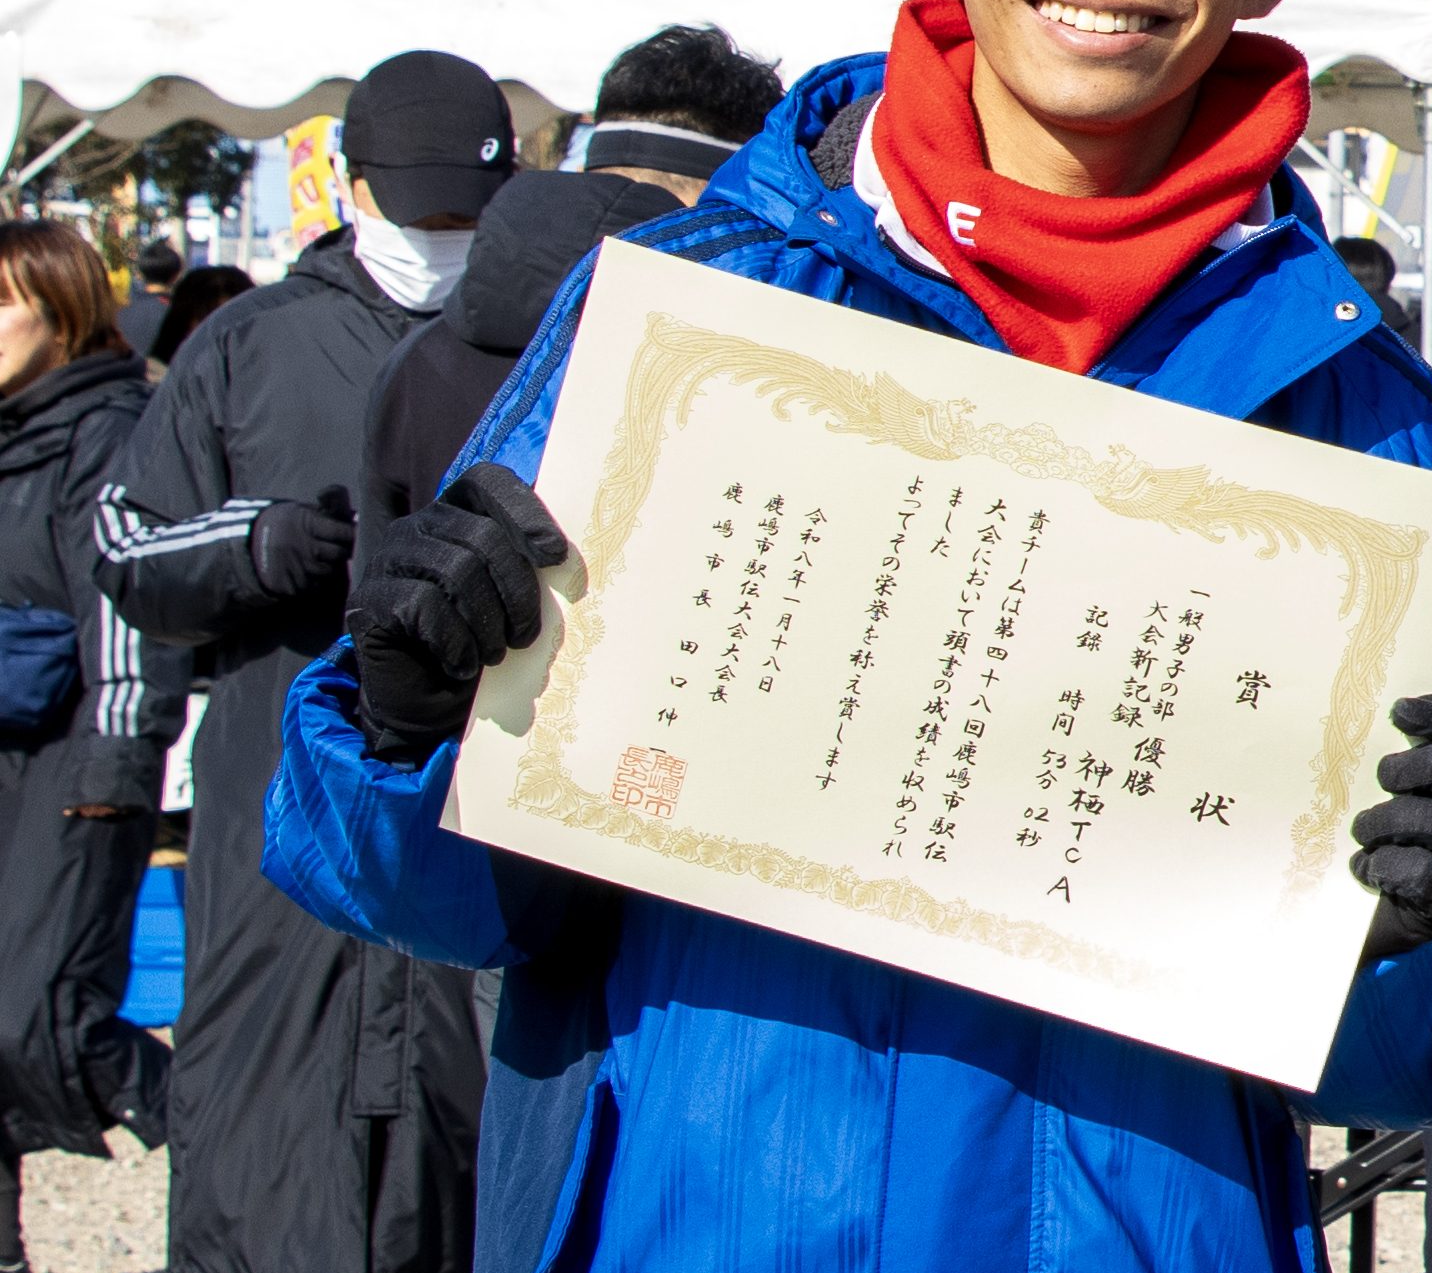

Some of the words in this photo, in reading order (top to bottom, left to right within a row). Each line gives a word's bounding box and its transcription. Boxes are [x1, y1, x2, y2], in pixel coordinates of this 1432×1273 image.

[930, 486, 963, 558] ました
[708, 495, 785, 704] 鹿嶋市駅伝大会大会長
[758, 508, 827, 693] 令和八年一月十八日
[1076, 605, 1109, 652] 記録
[1110, 600, 1168, 728] 大会新記録
[1151, 589, 1210, 721] 一般男子の部
[1051, 689, 1084, 736] 時間
[1121, 737, 1166, 796] 優勝
